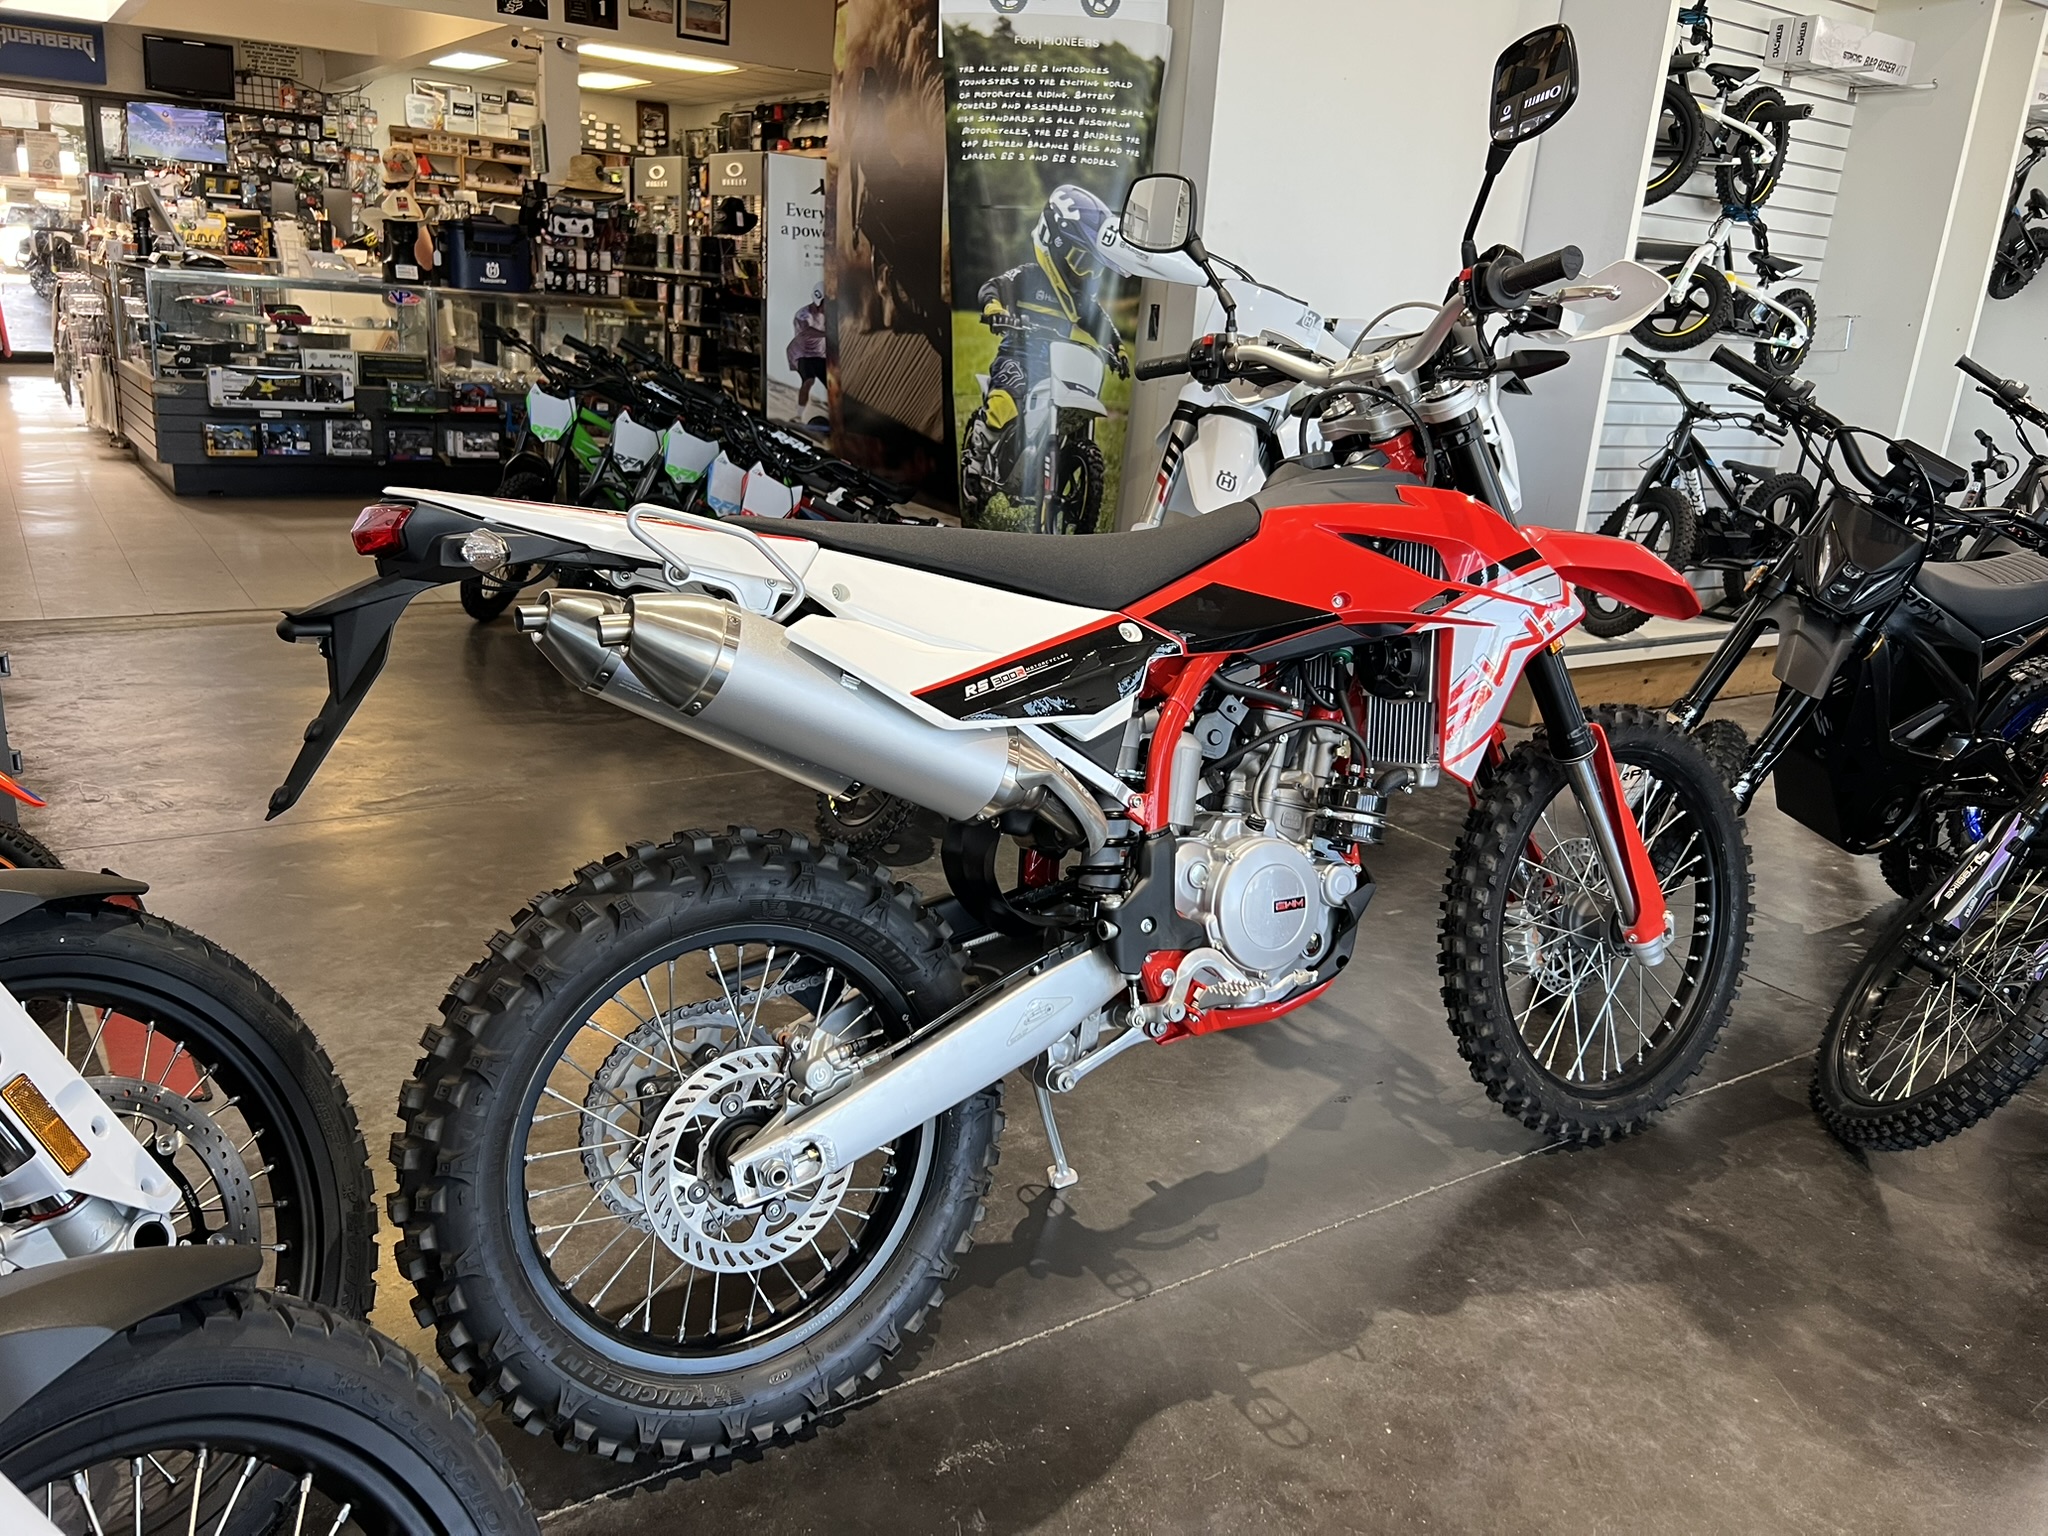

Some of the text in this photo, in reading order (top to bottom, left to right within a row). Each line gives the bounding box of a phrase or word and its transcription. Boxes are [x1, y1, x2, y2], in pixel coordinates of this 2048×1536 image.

[1015, 35, 1100, 48] FOR PIONEERS
[1024, 64, 1037, 72] EE
[1052, 66, 1109, 74] INTRODUCES
[1876, 60, 1896, 74] RISER
[959, 78, 1019, 86] YOUNGSTERS
[1037, 91, 1069, 99] RIDING.
[1074, 91, 1115, 100] BATTERY
[957, 102, 997, 110] POWERED
[1025, 104, 1081, 112] ASSEMBLED
[1120, 109, 1143, 118] SAME
[962, 126, 1030, 137] MOTORCYCLES,
[1055, 129, 1069, 137] EE
[1083, 131, 1122, 141] BRIDGES
[1027, 141, 1069, 150] BALANCE
[1073, 143, 1100, 152] BIKES
[1126, 150, 1139, 158] THE
[962, 152, 996, 160] LARGER
[1001, 152, 1014, 160] EE
[1029, 153, 1048, 161] AND
[1052, 154, 1066, 162] EE
[1081, 158, 1118, 167] MODELS.
[786, 202, 825, 222] Every
[781, 225, 789, 235] a
[531, 424, 560, 439] RFN
[614, 453, 645, 470] RFN
[665, 463, 698, 481] RFN
[965, 678, 989, 698] RS
[991, 667, 1026, 688] 300R
[795, 905, 912, 975] MICHELIN
[561, 1353, 699, 1406] MICHELIN
